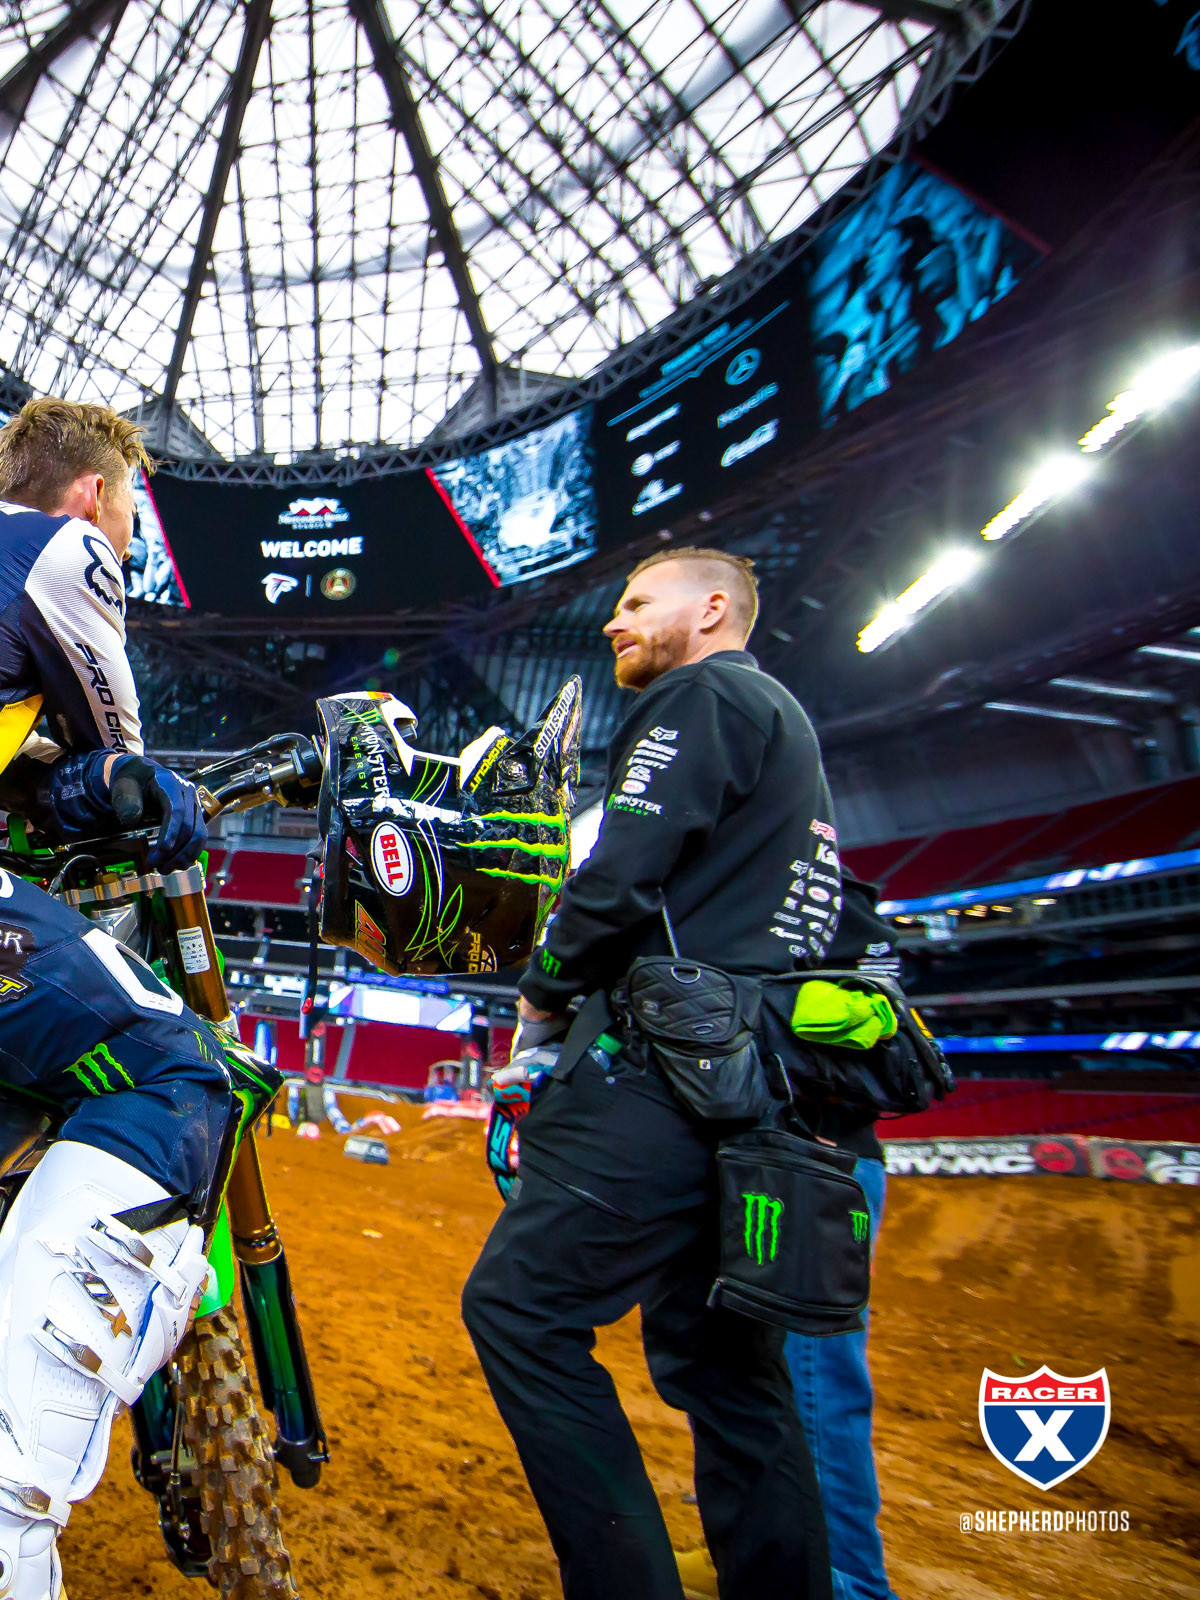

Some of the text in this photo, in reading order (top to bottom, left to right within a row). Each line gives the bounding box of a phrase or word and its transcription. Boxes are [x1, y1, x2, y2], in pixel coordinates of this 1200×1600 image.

[261, 536, 364, 558] WELCOME
[74, 642, 115, 706] PRO
[351, 736, 368, 790] ENERGY
[361, 725, 391, 800] MONSTER
[380, 834, 404, 887] BELL
